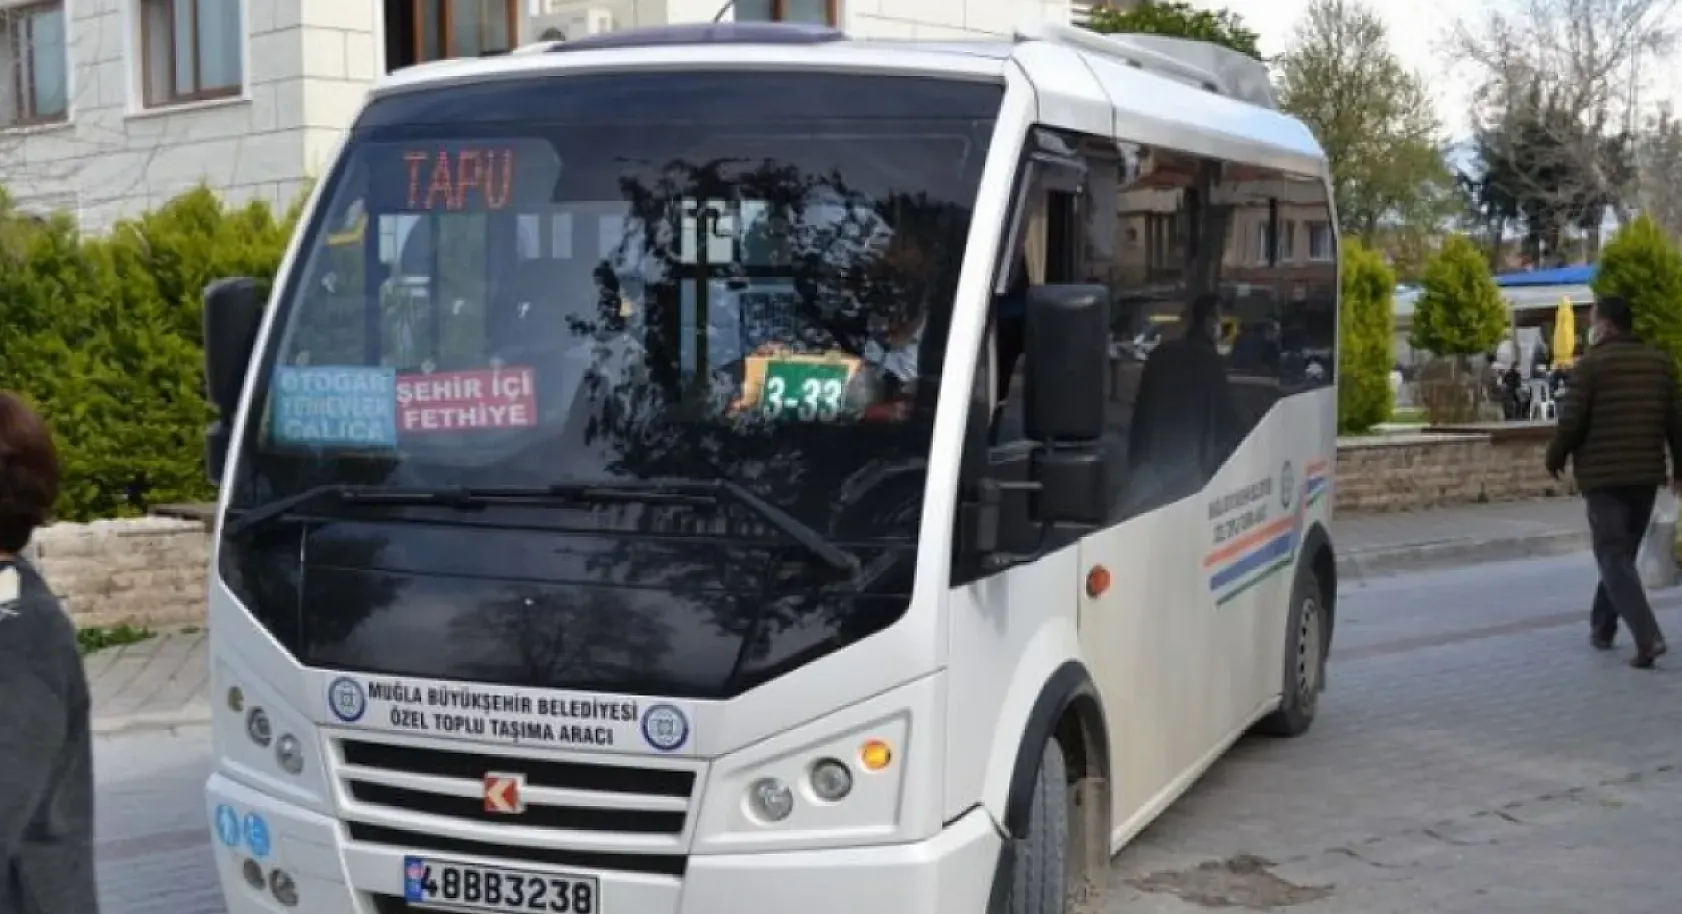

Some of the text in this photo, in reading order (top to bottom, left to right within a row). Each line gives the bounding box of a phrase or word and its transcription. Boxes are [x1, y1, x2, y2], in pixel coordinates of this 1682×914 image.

[403, 149, 513, 210] TAPU
[279, 371, 388, 393] OTOGAR
[397, 367, 533, 409] ŞEHİR İÇİ
[765, 376, 842, 422] 3-33
[404, 402, 529, 430] FETHİYE
[367, 680, 639, 722] MUĞLA BÜYÜKŞEHİR BELEDİYESİ
[390, 704, 615, 746] ÖZEL TOPLU TAŞIMA ARACI
[420, 864, 592, 914] 48BB3238
